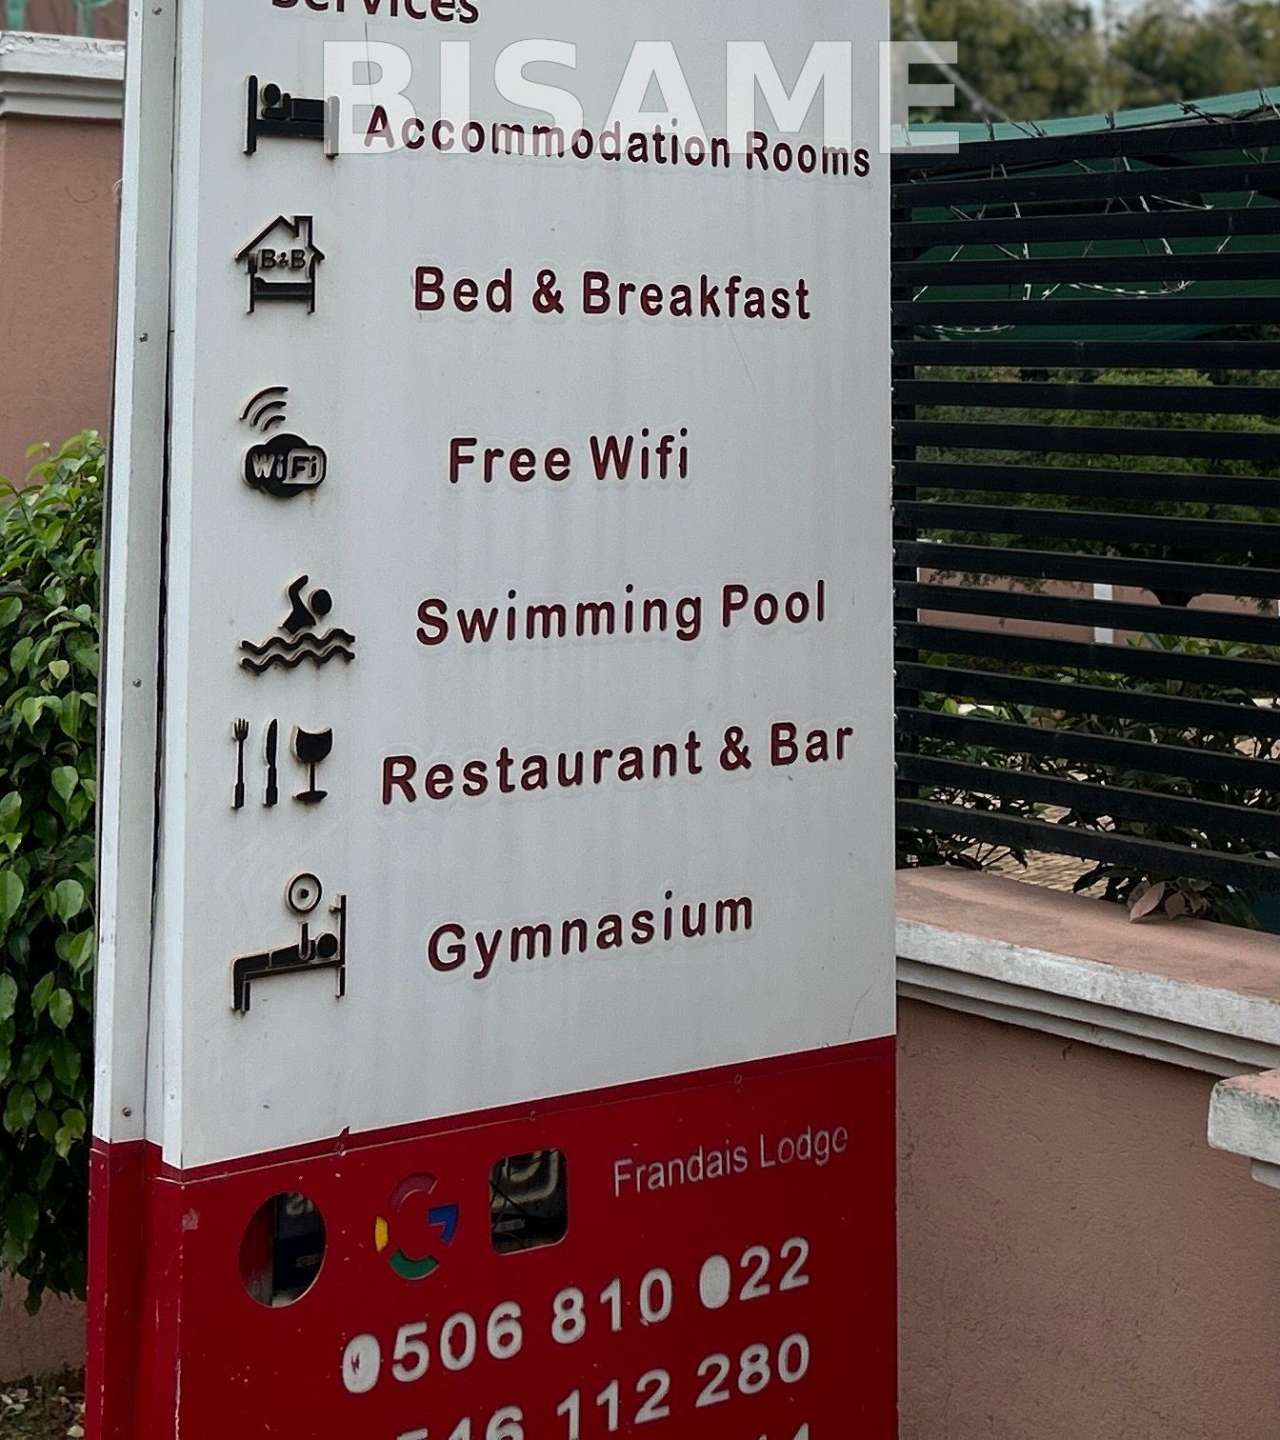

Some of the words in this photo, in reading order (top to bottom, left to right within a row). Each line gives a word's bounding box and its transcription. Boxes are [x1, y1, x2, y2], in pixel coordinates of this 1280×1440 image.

[363, 105, 731, 169] Accommodation
[745, 129, 872, 178] Rooms
[261, 248, 306, 269] B&B
[414, 265, 512, 313] Bed
[531, 268, 565, 315] &
[582, 269, 812, 321] Breakfast
[449, 437, 571, 484] Free
[590, 427, 689, 481] Wifi
[415, 583, 703, 647] Swimming
[721, 579, 826, 629] Pool
[382, 730, 701, 806] Restaurant
[719, 726, 752, 771] &
[770, 721, 854, 766] Bar
[427, 890, 754, 980] Gymnasium
[613, 1139, 748, 1198] Frandais
[760, 1125, 849, 1166] Lodge
[341, 1300, 522, 1394] 0506
[551, 1268, 673, 1344] 810
[699, 1236, 810, 1310] 022
[556, 1369, 671, 1440] 112
[695, 1332, 811, 1408] 280
